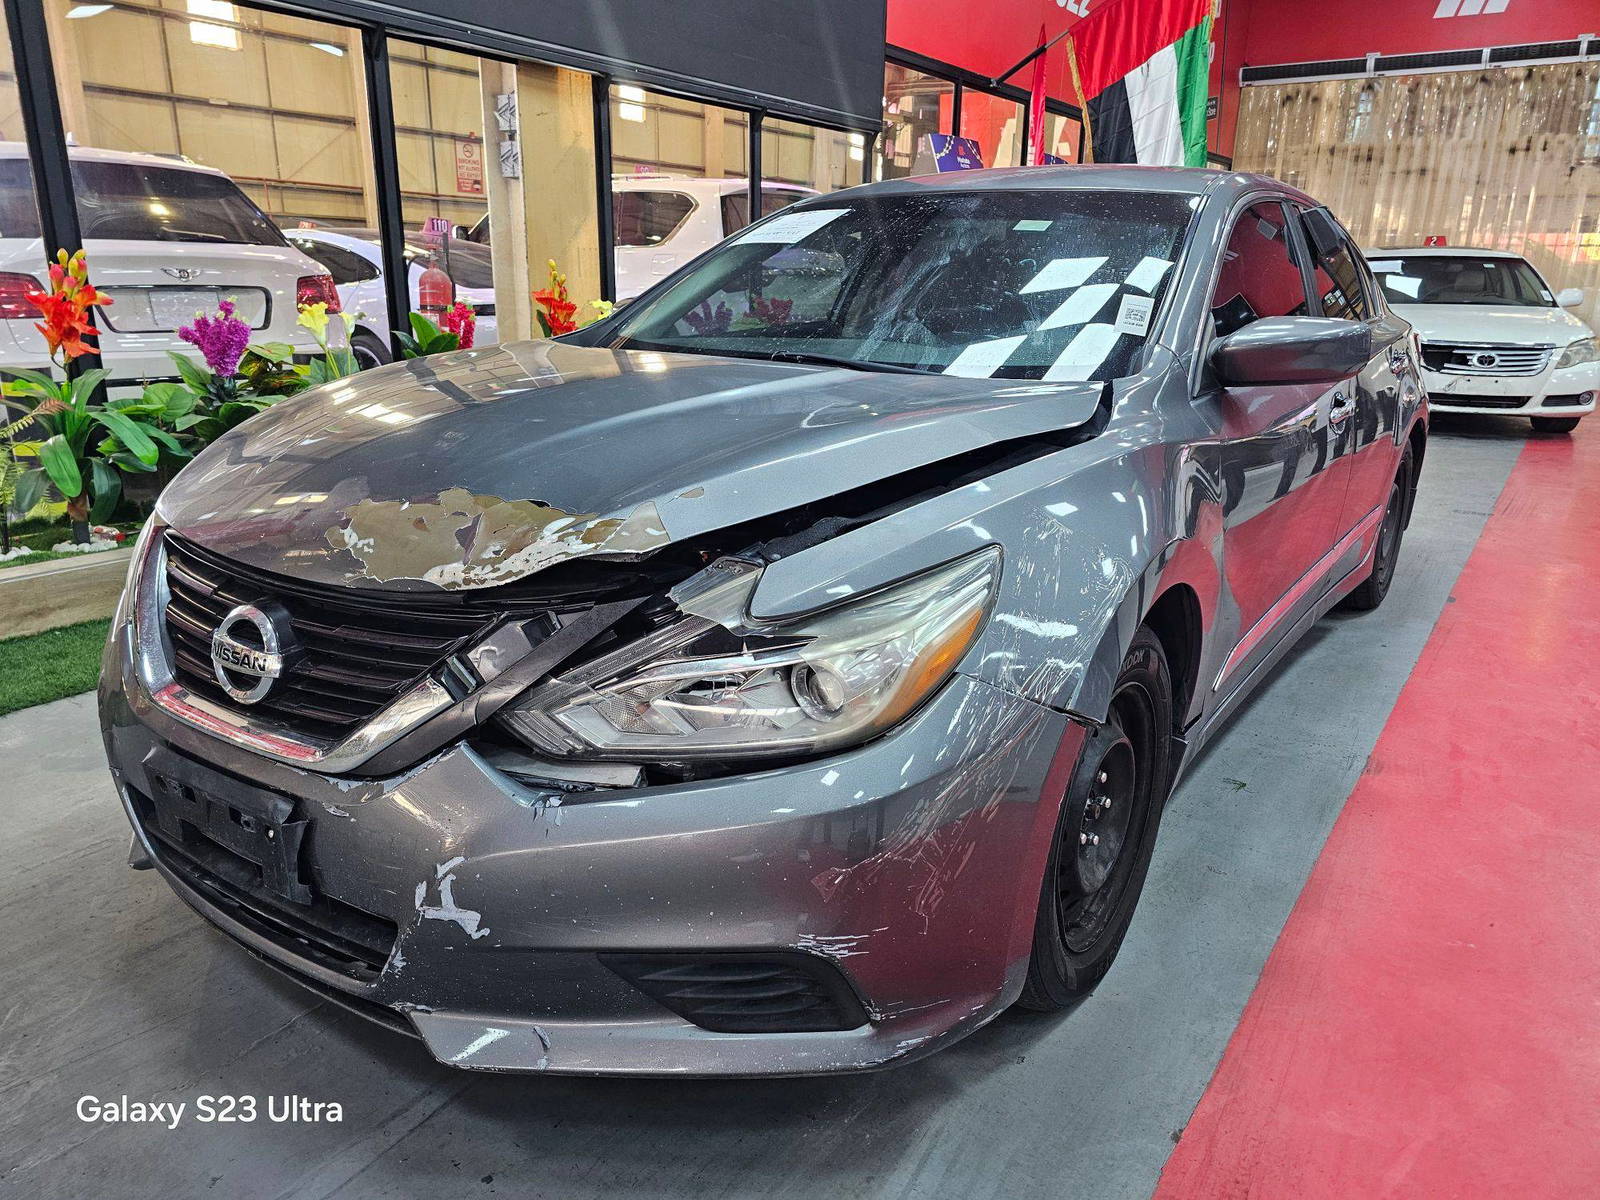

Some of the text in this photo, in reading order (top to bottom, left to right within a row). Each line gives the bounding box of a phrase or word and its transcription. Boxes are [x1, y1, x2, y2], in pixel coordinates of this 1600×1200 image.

[431, 218, 449, 233] 110
[1430, 236, 1438, 246] 2
[212, 640, 267, 672] NISSAN
